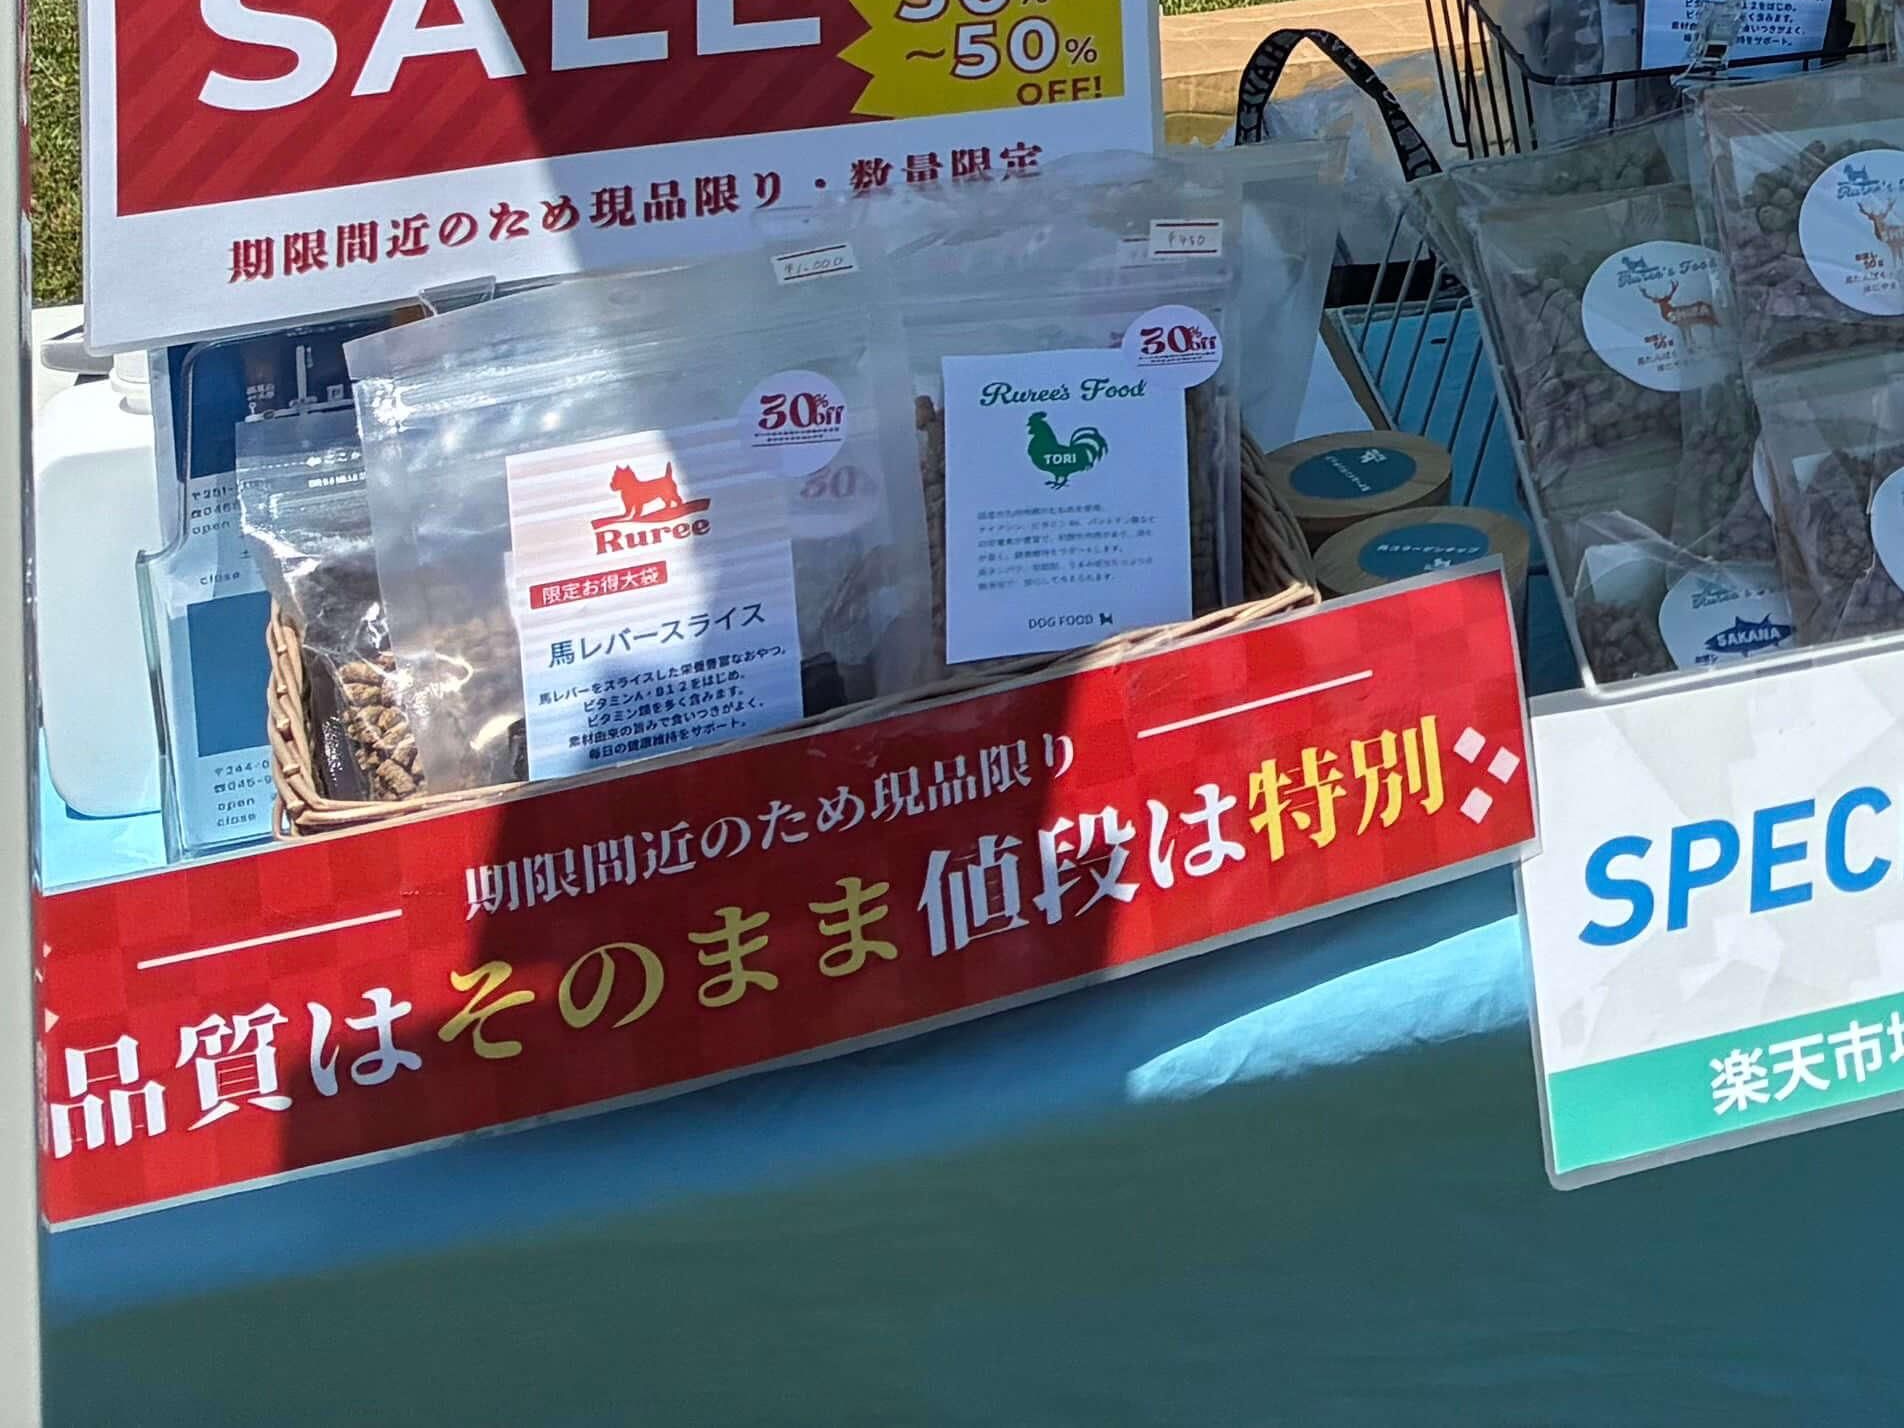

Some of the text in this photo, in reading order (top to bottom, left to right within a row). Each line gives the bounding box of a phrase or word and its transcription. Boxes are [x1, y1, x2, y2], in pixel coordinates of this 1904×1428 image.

[979, 378, 1148, 407] Ruree's Food
[1044, 453, 1077, 465] TORI
[595, 516, 711, 555] Ruree
[542, 568, 660, 605] 限定お得大袋
[549, 603, 766, 668] 馬レバースライス
[1029, 615, 1094, 629] DOG FOOD
[1717, 624, 1781, 647] SAKANA
[462, 733, 1078, 923] 期限間近のため現品限り
